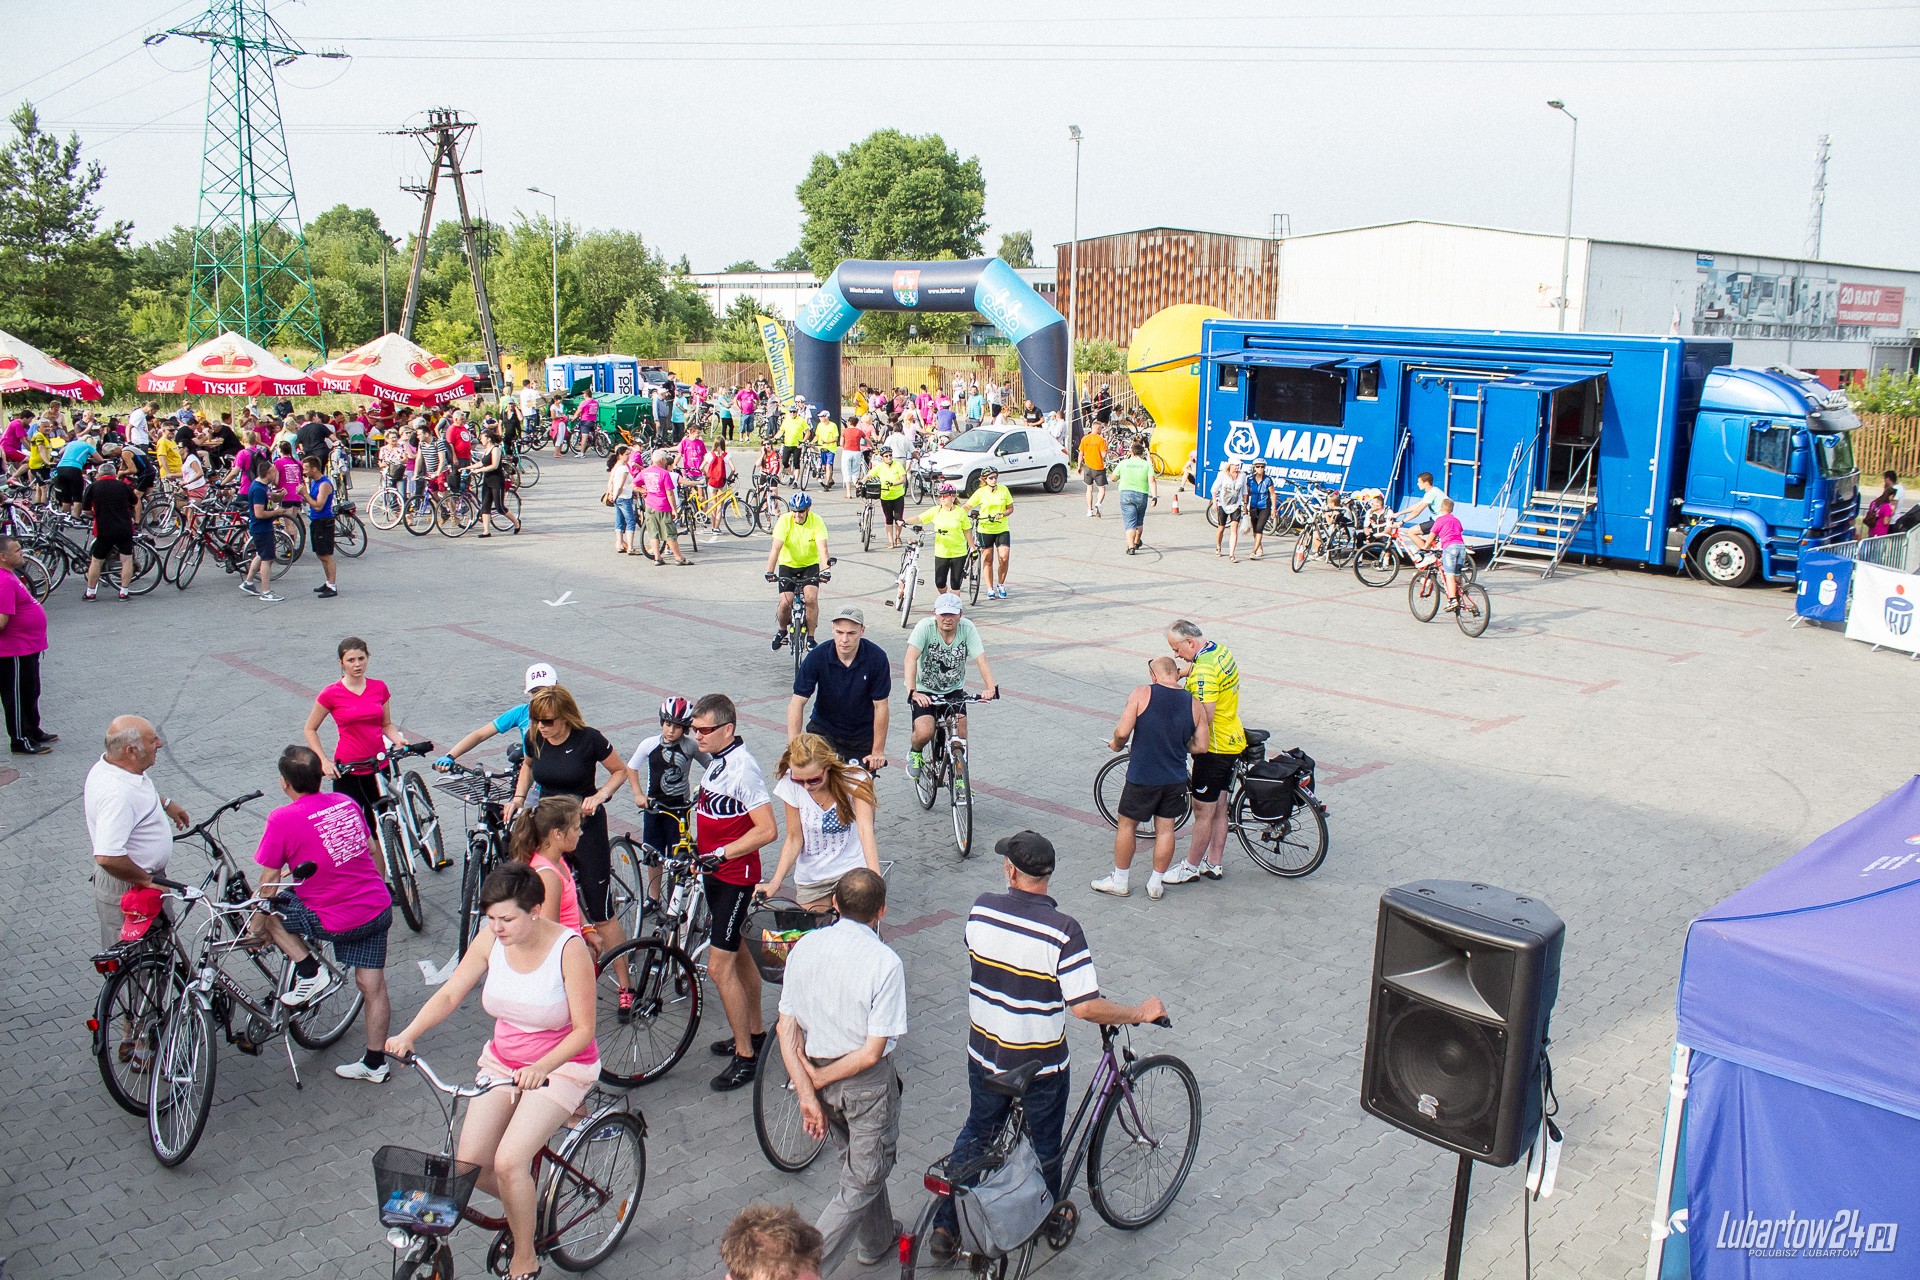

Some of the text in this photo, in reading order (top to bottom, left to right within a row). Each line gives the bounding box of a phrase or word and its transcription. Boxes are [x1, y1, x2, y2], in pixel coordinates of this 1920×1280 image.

[1840, 287, 1855, 304] 20
[1854, 290, 1873, 306] RAT
[148, 379, 177, 391] TYSKIE
[202, 381, 247, 394] TYSKIE
[274, 383, 307, 395] TYSKIE
[322, 377, 351, 391] TYSKIE
[435, 384, 466, 403] TYSKIE
[373, 384, 412, 404] TYSKIE
[1264, 428, 1359, 466] MAPEI
[1289, 467, 1342, 484] SZKOLENIOWE
[531, 670, 547, 680] GAP
[725, 891, 745, 941] NORTHWAVE
[220, 973, 253, 1005] KANDS
[693, 972, 702, 998] SPEED
